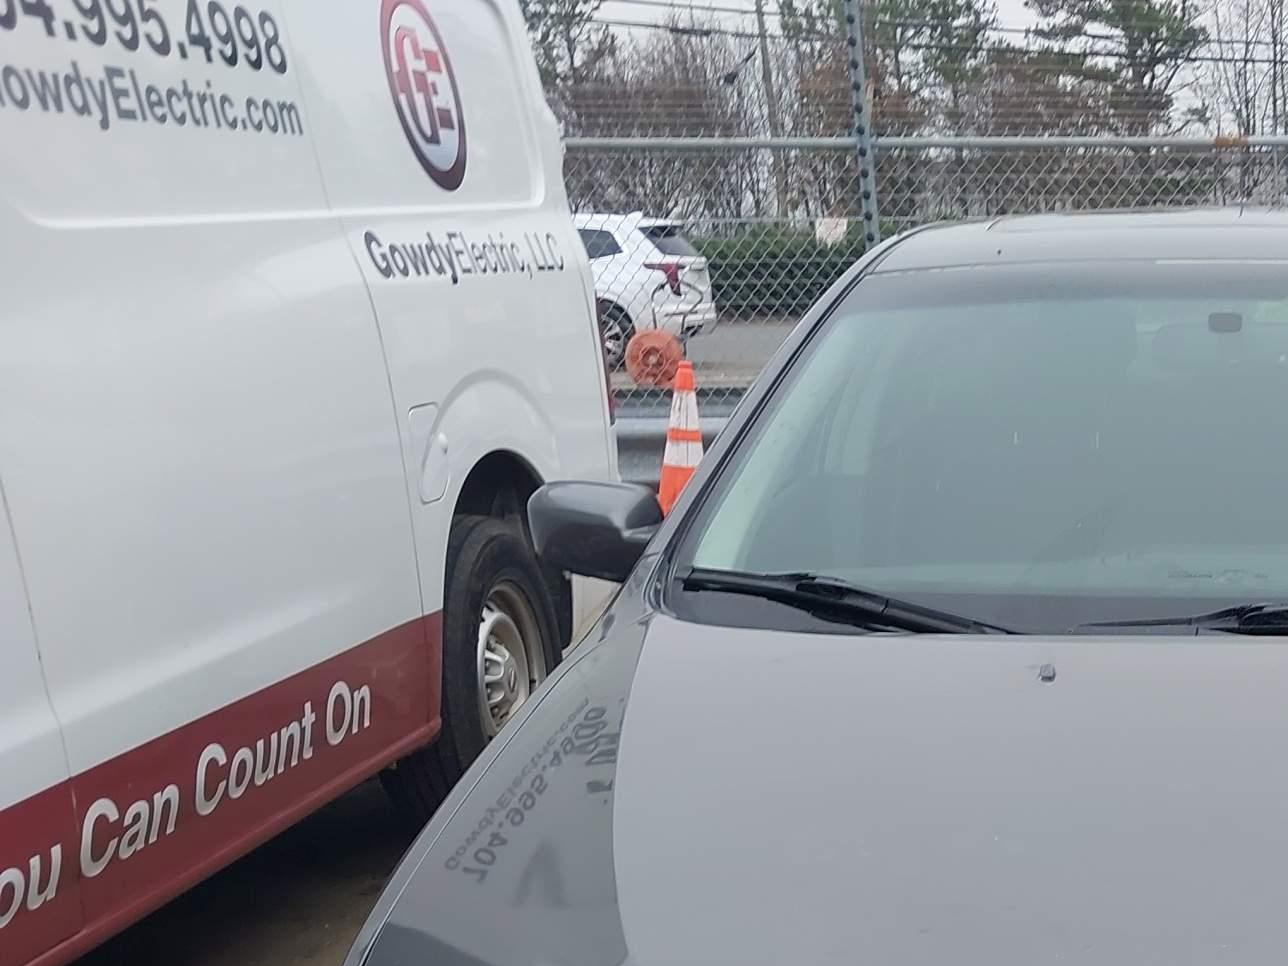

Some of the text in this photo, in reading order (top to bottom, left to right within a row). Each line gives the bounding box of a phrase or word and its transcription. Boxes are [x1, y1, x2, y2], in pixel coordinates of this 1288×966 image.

[0, 60, 304, 136] owdyElectric.com
[526, 232, 564, 271] LLC
[80, 783, 180, 877] Can
[195, 701, 315, 816] Count
[326, 681, 370, 745] On
